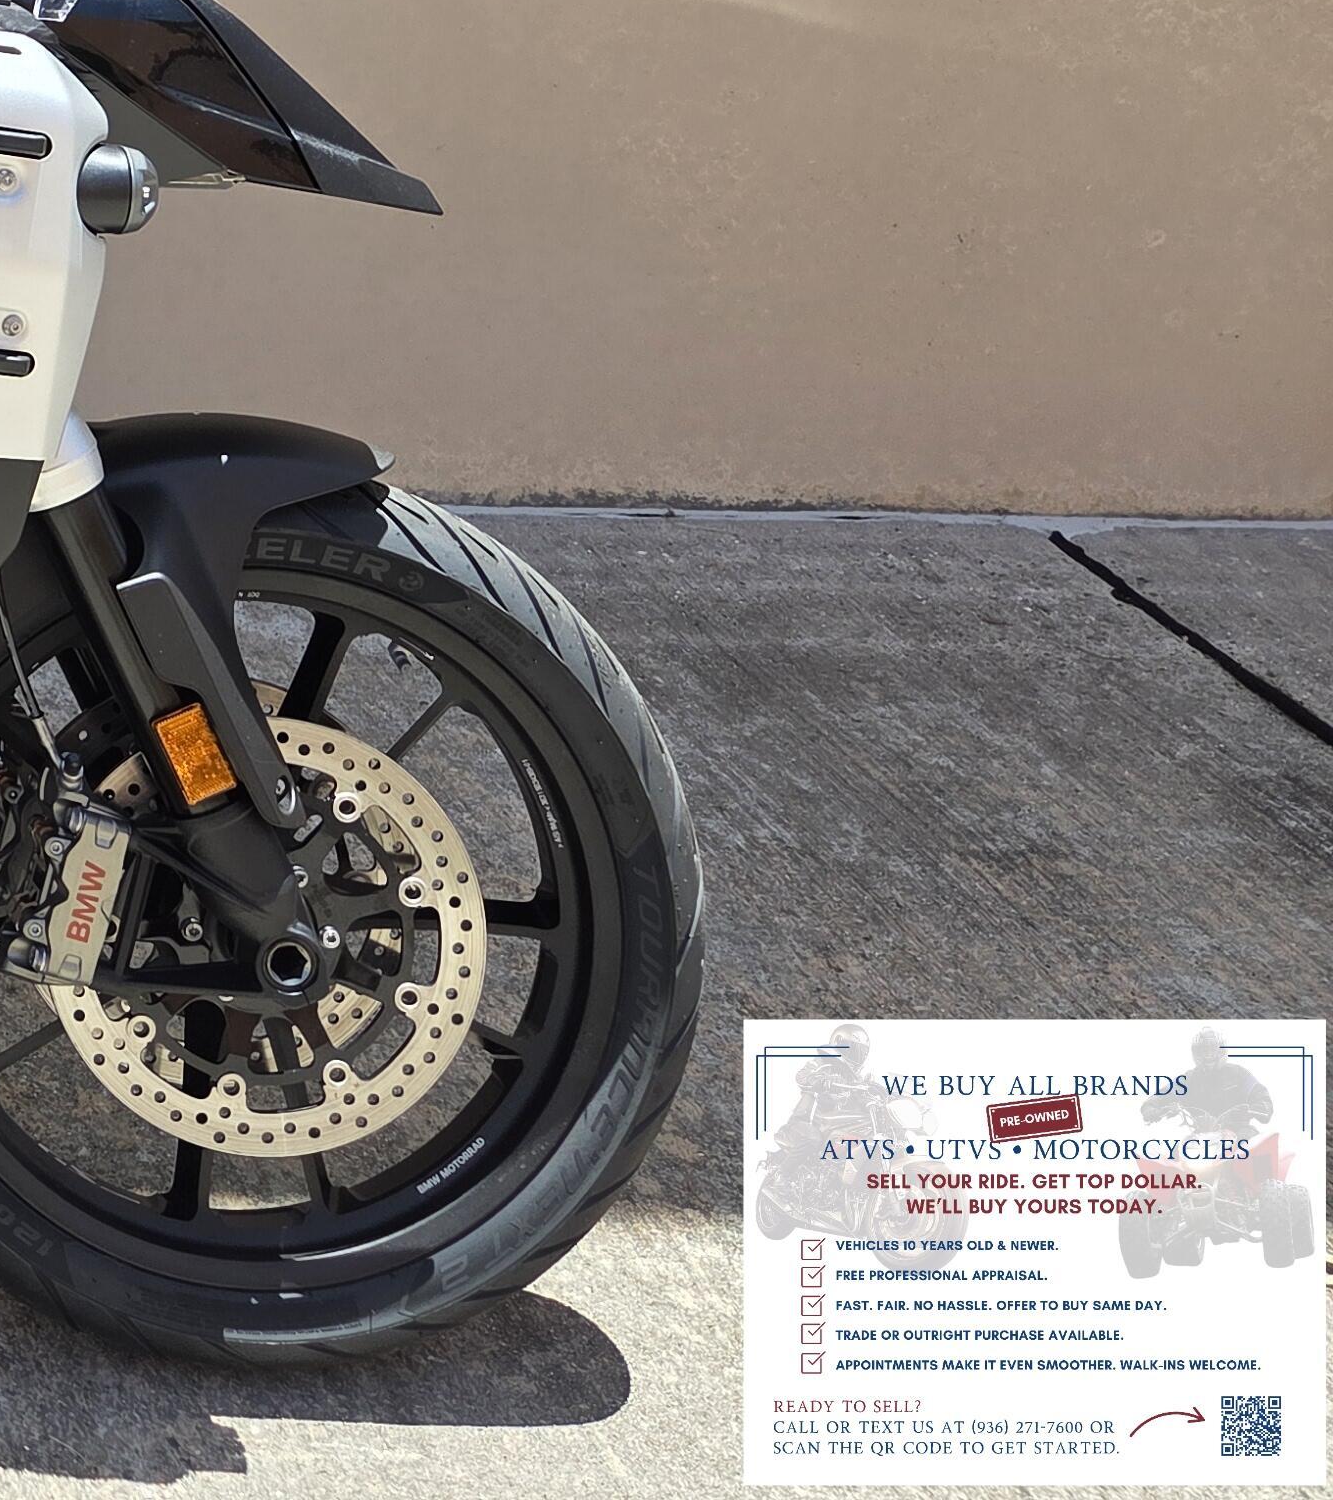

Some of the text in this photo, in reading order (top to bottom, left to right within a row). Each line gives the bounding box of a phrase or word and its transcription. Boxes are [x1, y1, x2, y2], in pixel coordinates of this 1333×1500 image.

[244, 536, 392, 583] ELER
[66, 860, 107, 944] BMW
[415, 1136, 486, 1195] BMW MOTORRAD
